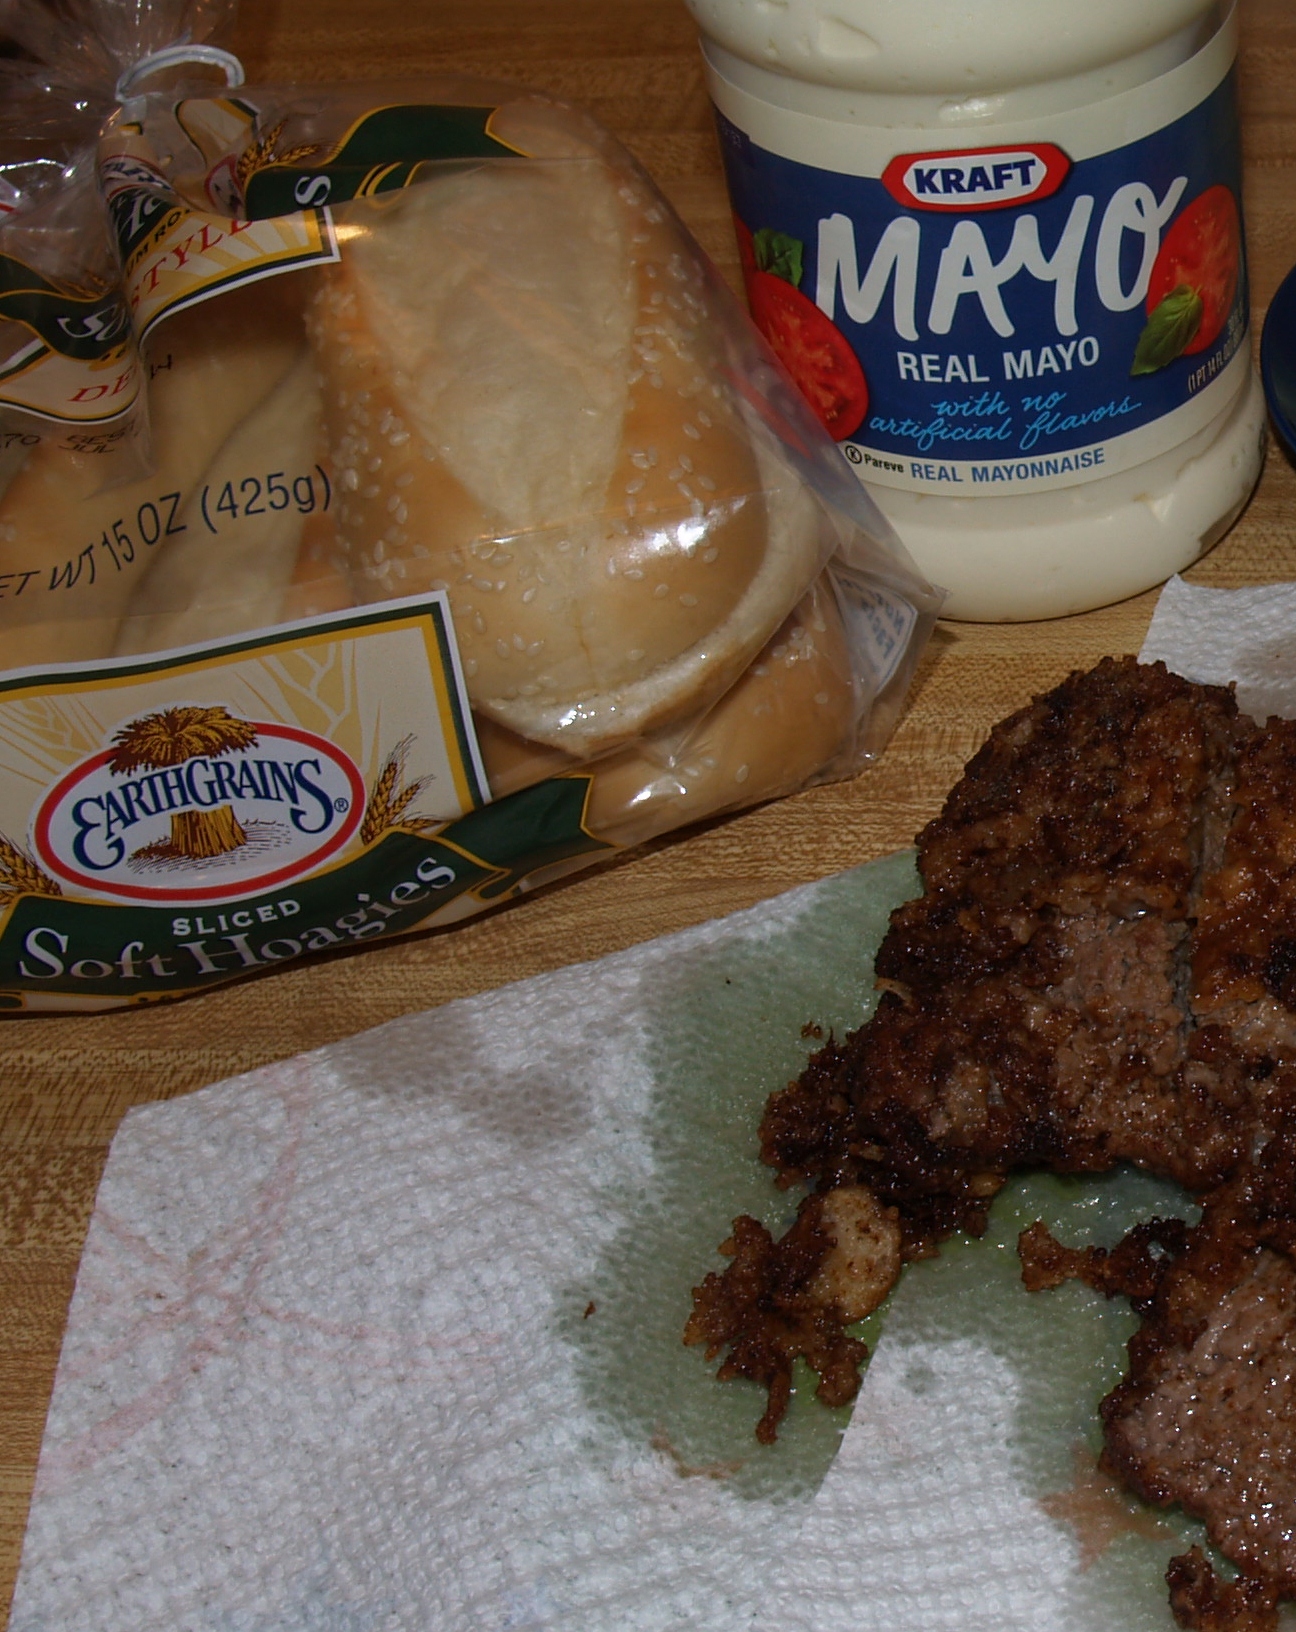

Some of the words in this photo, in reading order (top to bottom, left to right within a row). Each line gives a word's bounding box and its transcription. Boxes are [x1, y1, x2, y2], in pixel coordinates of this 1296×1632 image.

[914, 160, 1037, 195] KRAFT
[816, 176, 1189, 341] MAYO
[896, 350, 990, 384] REAL
[1003, 336, 1100, 380] MAYO
[869, 416, 1013, 451] artificial
[1018, 397, 1144, 451] flavors
[930, 390, 1011, 418] with
[1020, 390, 1068, 412] no
[864, 453, 904, 473] Pareve
[910, 462, 964, 483] REAL
[971, 447, 1105, 483] MAYONNAISE
[48, 543, 96, 591] WT
[102, 520, 135, 572] 15
[137, 492, 188, 546] OZ
[201, 463, 332, 534] (425g)
[72, 758, 335, 871] EARTHGRAINS
[18, 926, 178, 980] Soft
[177, 855, 457, 976] Hoagies
[171, 900, 302, 938] SLICED
